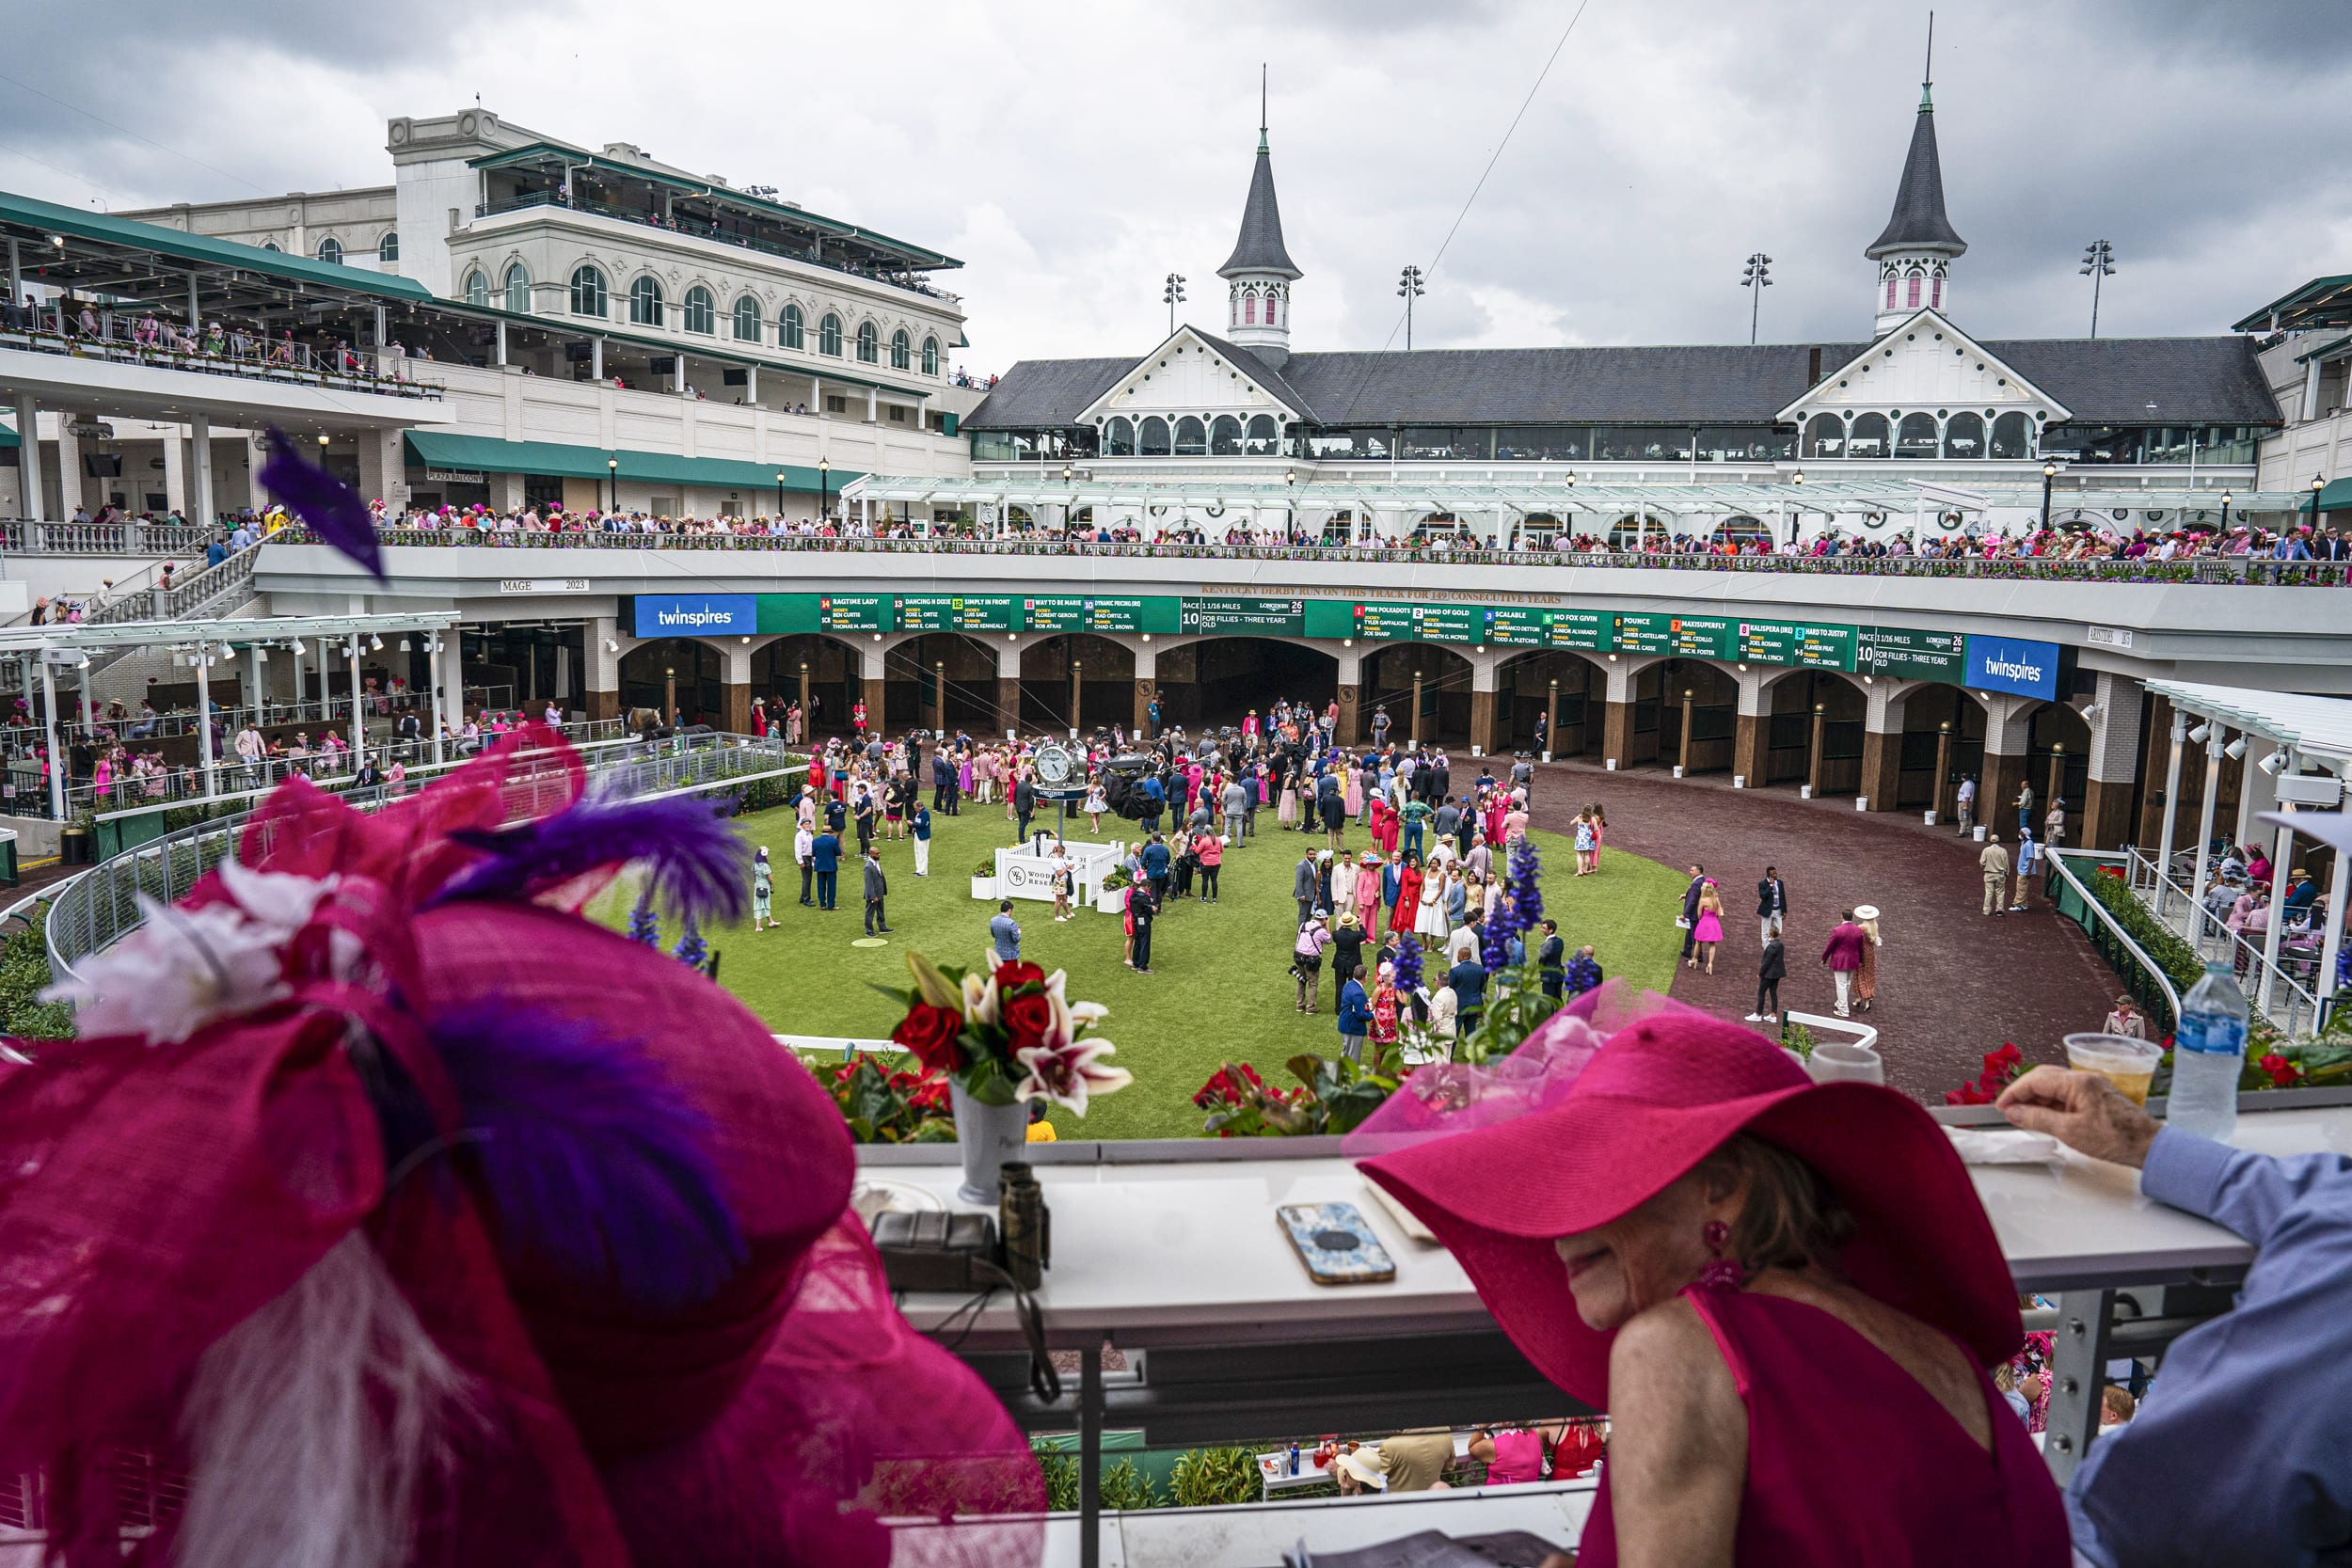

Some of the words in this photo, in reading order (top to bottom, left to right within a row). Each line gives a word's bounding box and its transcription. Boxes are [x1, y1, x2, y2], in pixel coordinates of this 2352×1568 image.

[452, 474, 483, 483] BALCONY
[502, 580, 532, 591] MAGE
[566, 580, 584, 589] 2023
[1201, 586, 1258, 594] KENTUCKY
[1261, 587, 1295, 595] DERBY
[1370, 589, 1404, 598] TRACK
[1431, 591, 1447, 599] 149
[1451, 592, 1524, 602] CONSECUTIVE
[1527, 594, 1562, 604] YEARS
[659, 603, 732, 626] twinspires
[1183, 613, 1199, 625] 10
[1682, 621, 1726, 629] MAXISUPERFLY
[1750, 625, 1780, 633] KALISPERA
[1827, 629, 1848, 638] JUSTIFY
[1859, 633, 1874, 641] RACE
[1894, 636, 1911, 644] MILES
[1953, 636, 1963, 646] 26
[1858, 646, 1873, 661] 10
[1875, 658, 1887, 667] OLD
[1888, 653, 1907, 661] FILLIES
[1913, 655, 1930, 663] THREE
[1931, 657, 1947, 666] YEARS
[1986, 649, 2041, 682] twinspires
[1028, 870, 1052, 879] WOOD
